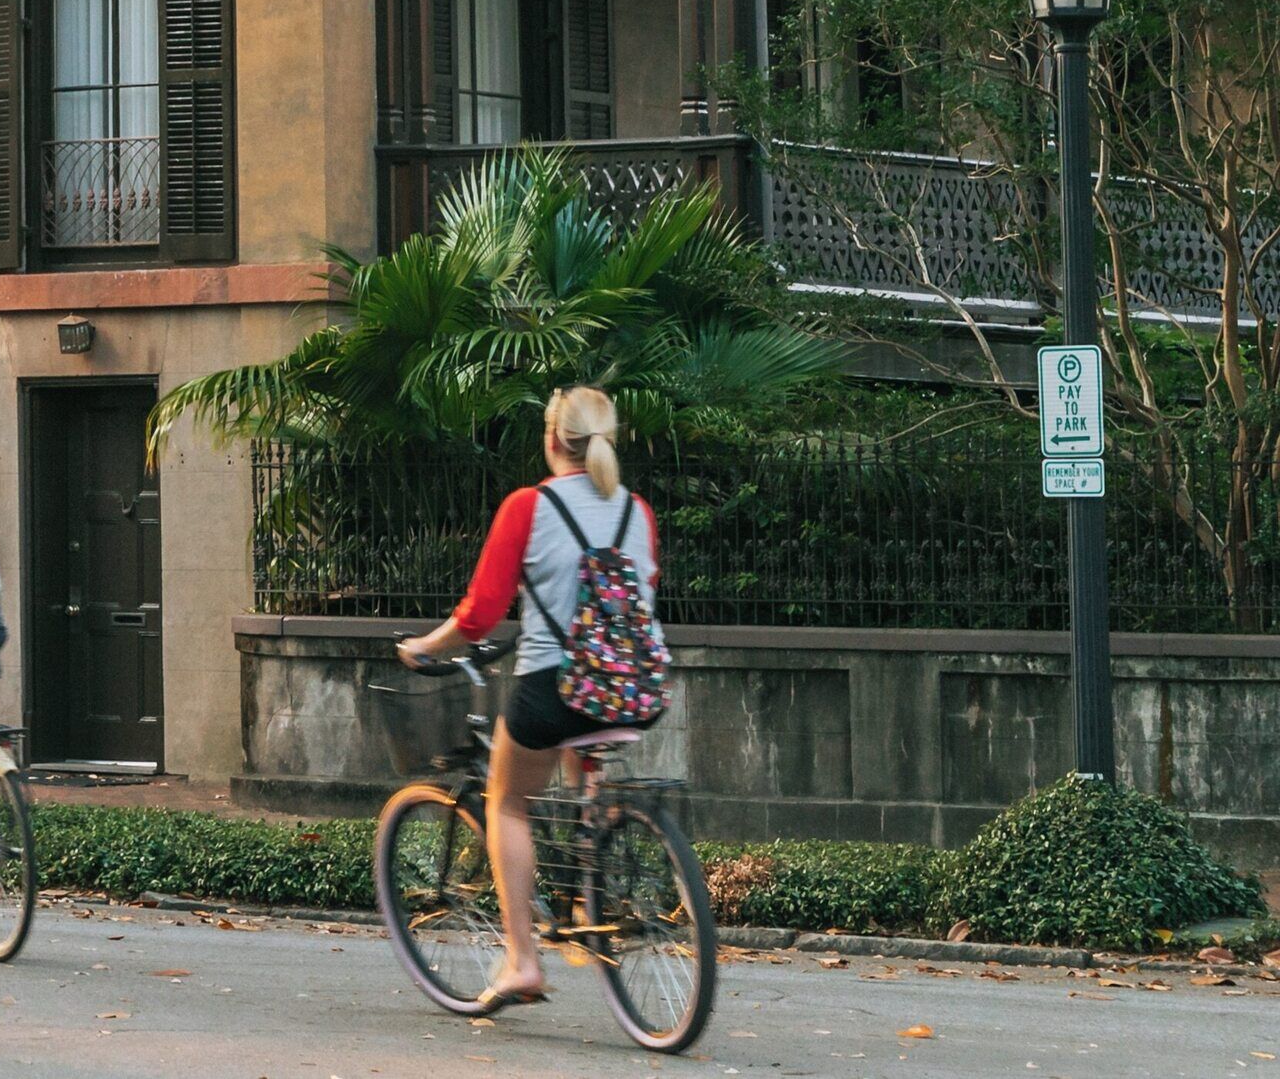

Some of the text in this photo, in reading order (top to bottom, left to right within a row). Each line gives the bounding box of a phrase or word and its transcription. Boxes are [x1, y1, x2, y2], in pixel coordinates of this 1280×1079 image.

[1064, 360, 1077, 377] P
[1059, 385, 1082, 399] PAY
[1064, 401, 1078, 415] TO
[1056, 417, 1087, 431] PARK
[1047, 467, 1099, 477] REMEMBER YOUR
[1055, 479, 1074, 488] SPACE
